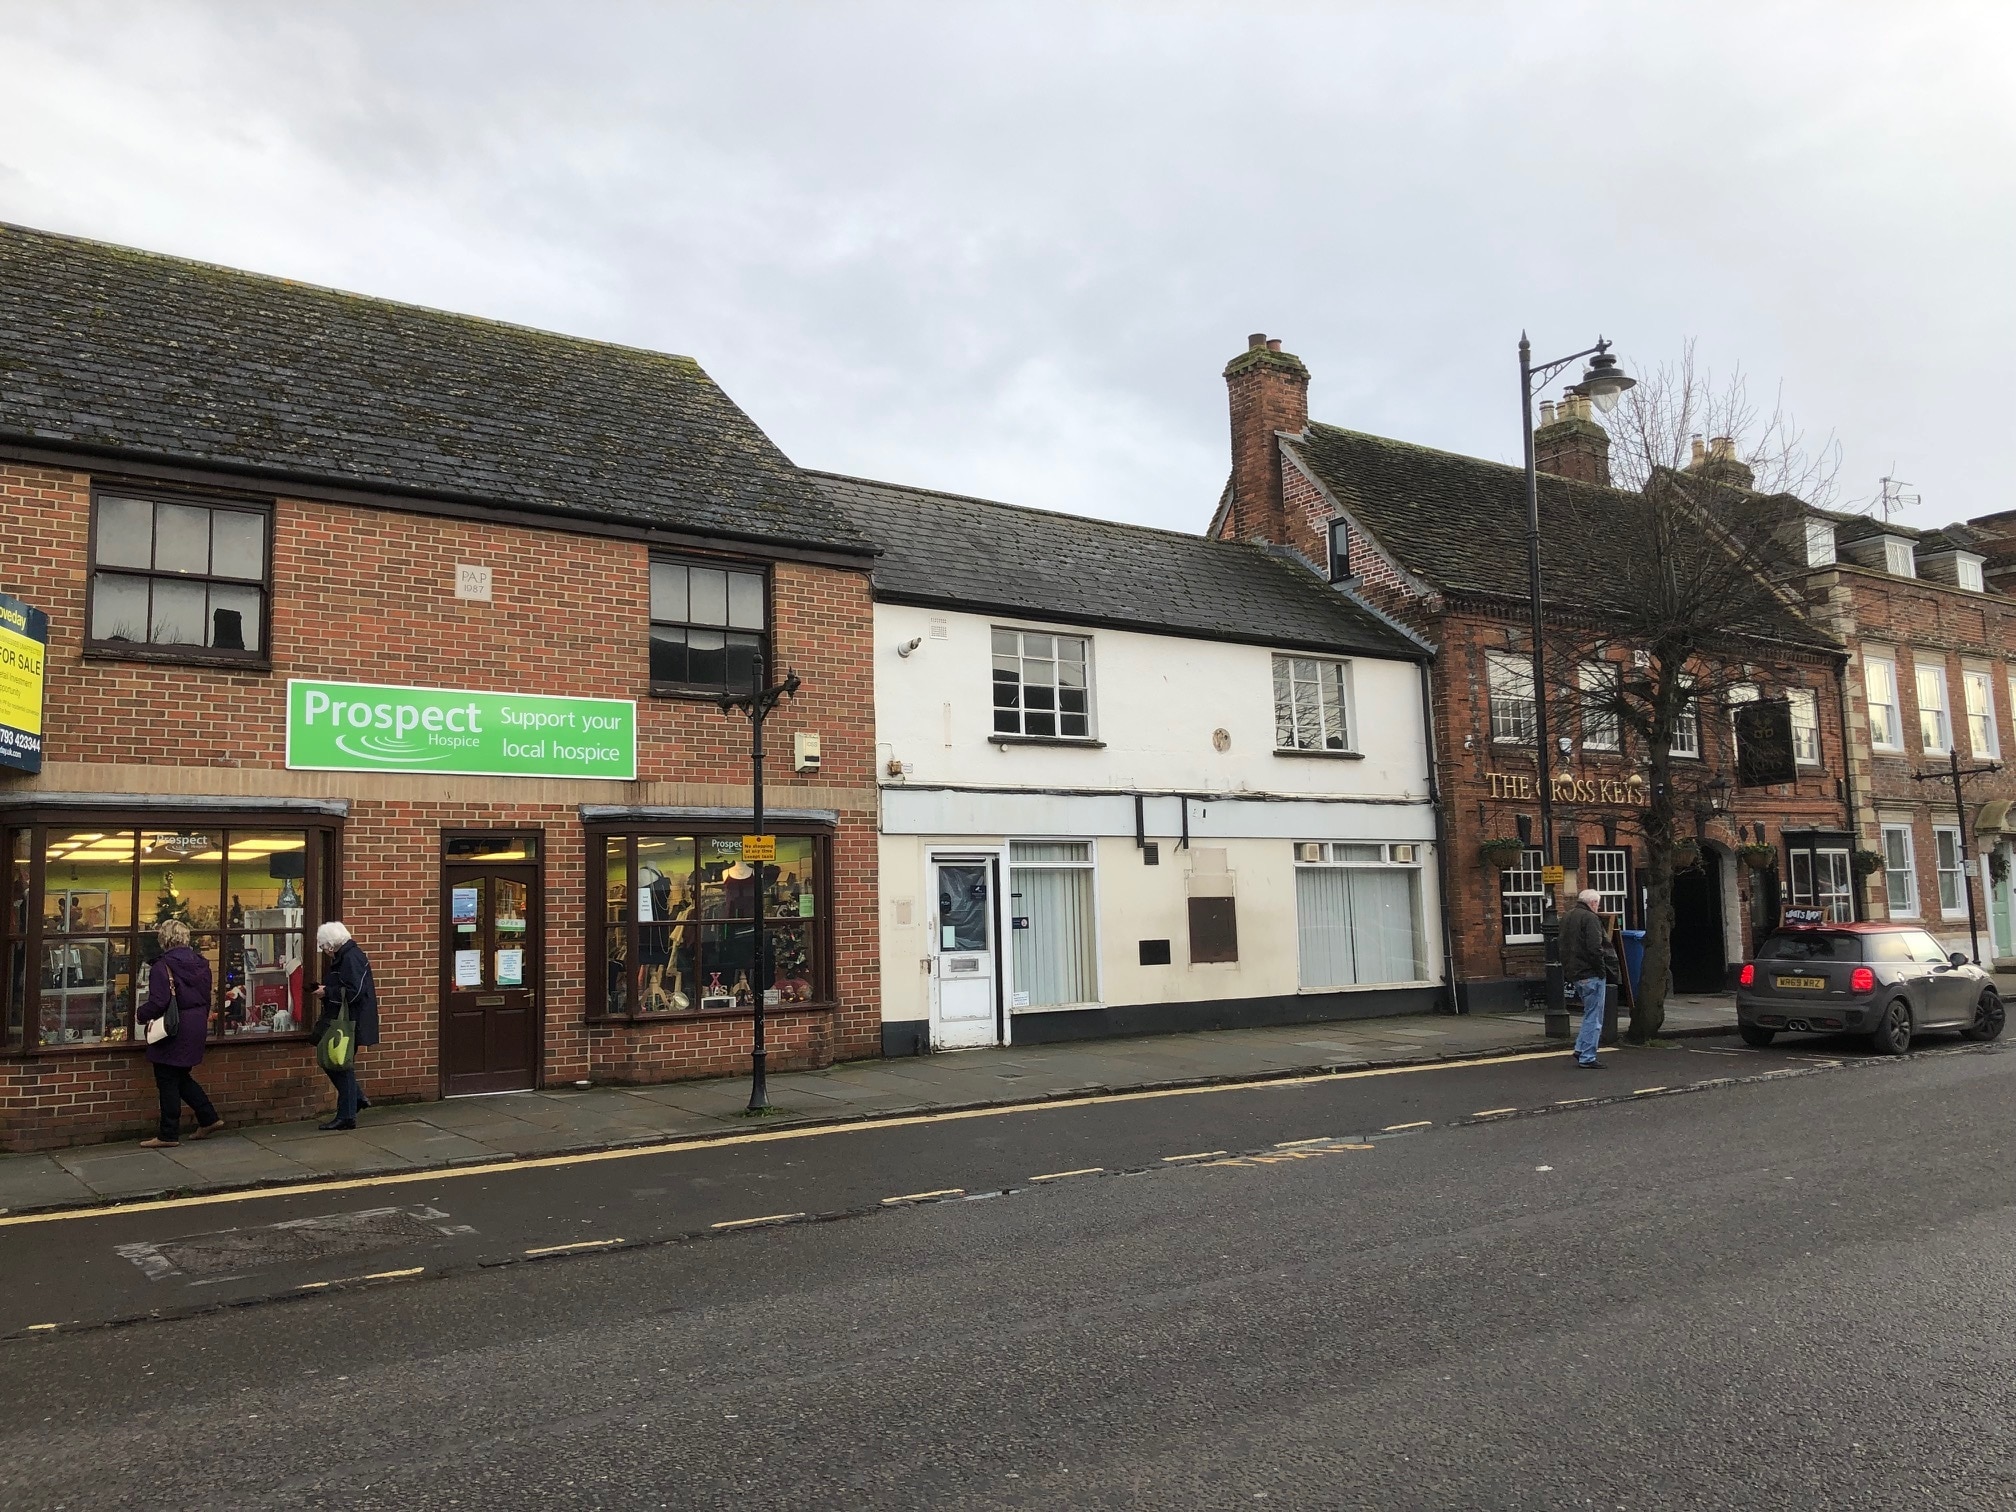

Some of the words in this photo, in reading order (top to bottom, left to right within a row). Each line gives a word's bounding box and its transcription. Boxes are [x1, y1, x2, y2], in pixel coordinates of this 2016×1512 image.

[462, 570, 487, 583] PAP
[464, 584, 484, 593] 1987
[18, 654, 41, 676] SALE
[305, 690, 482, 738] Prospect
[428, 733, 480, 749] Hospice
[501, 706, 575, 730] Support
[582, 714, 622, 732] your
[15, 733, 41, 753] 423344
[503, 738, 544, 759] local
[553, 741, 619, 764] hospice
[1486, 772, 1531, 800] THE
[1598, 778, 1643, 805] KEYS
[157, 834, 208, 847] Prospect
[711, 839, 742, 849] Prospec
